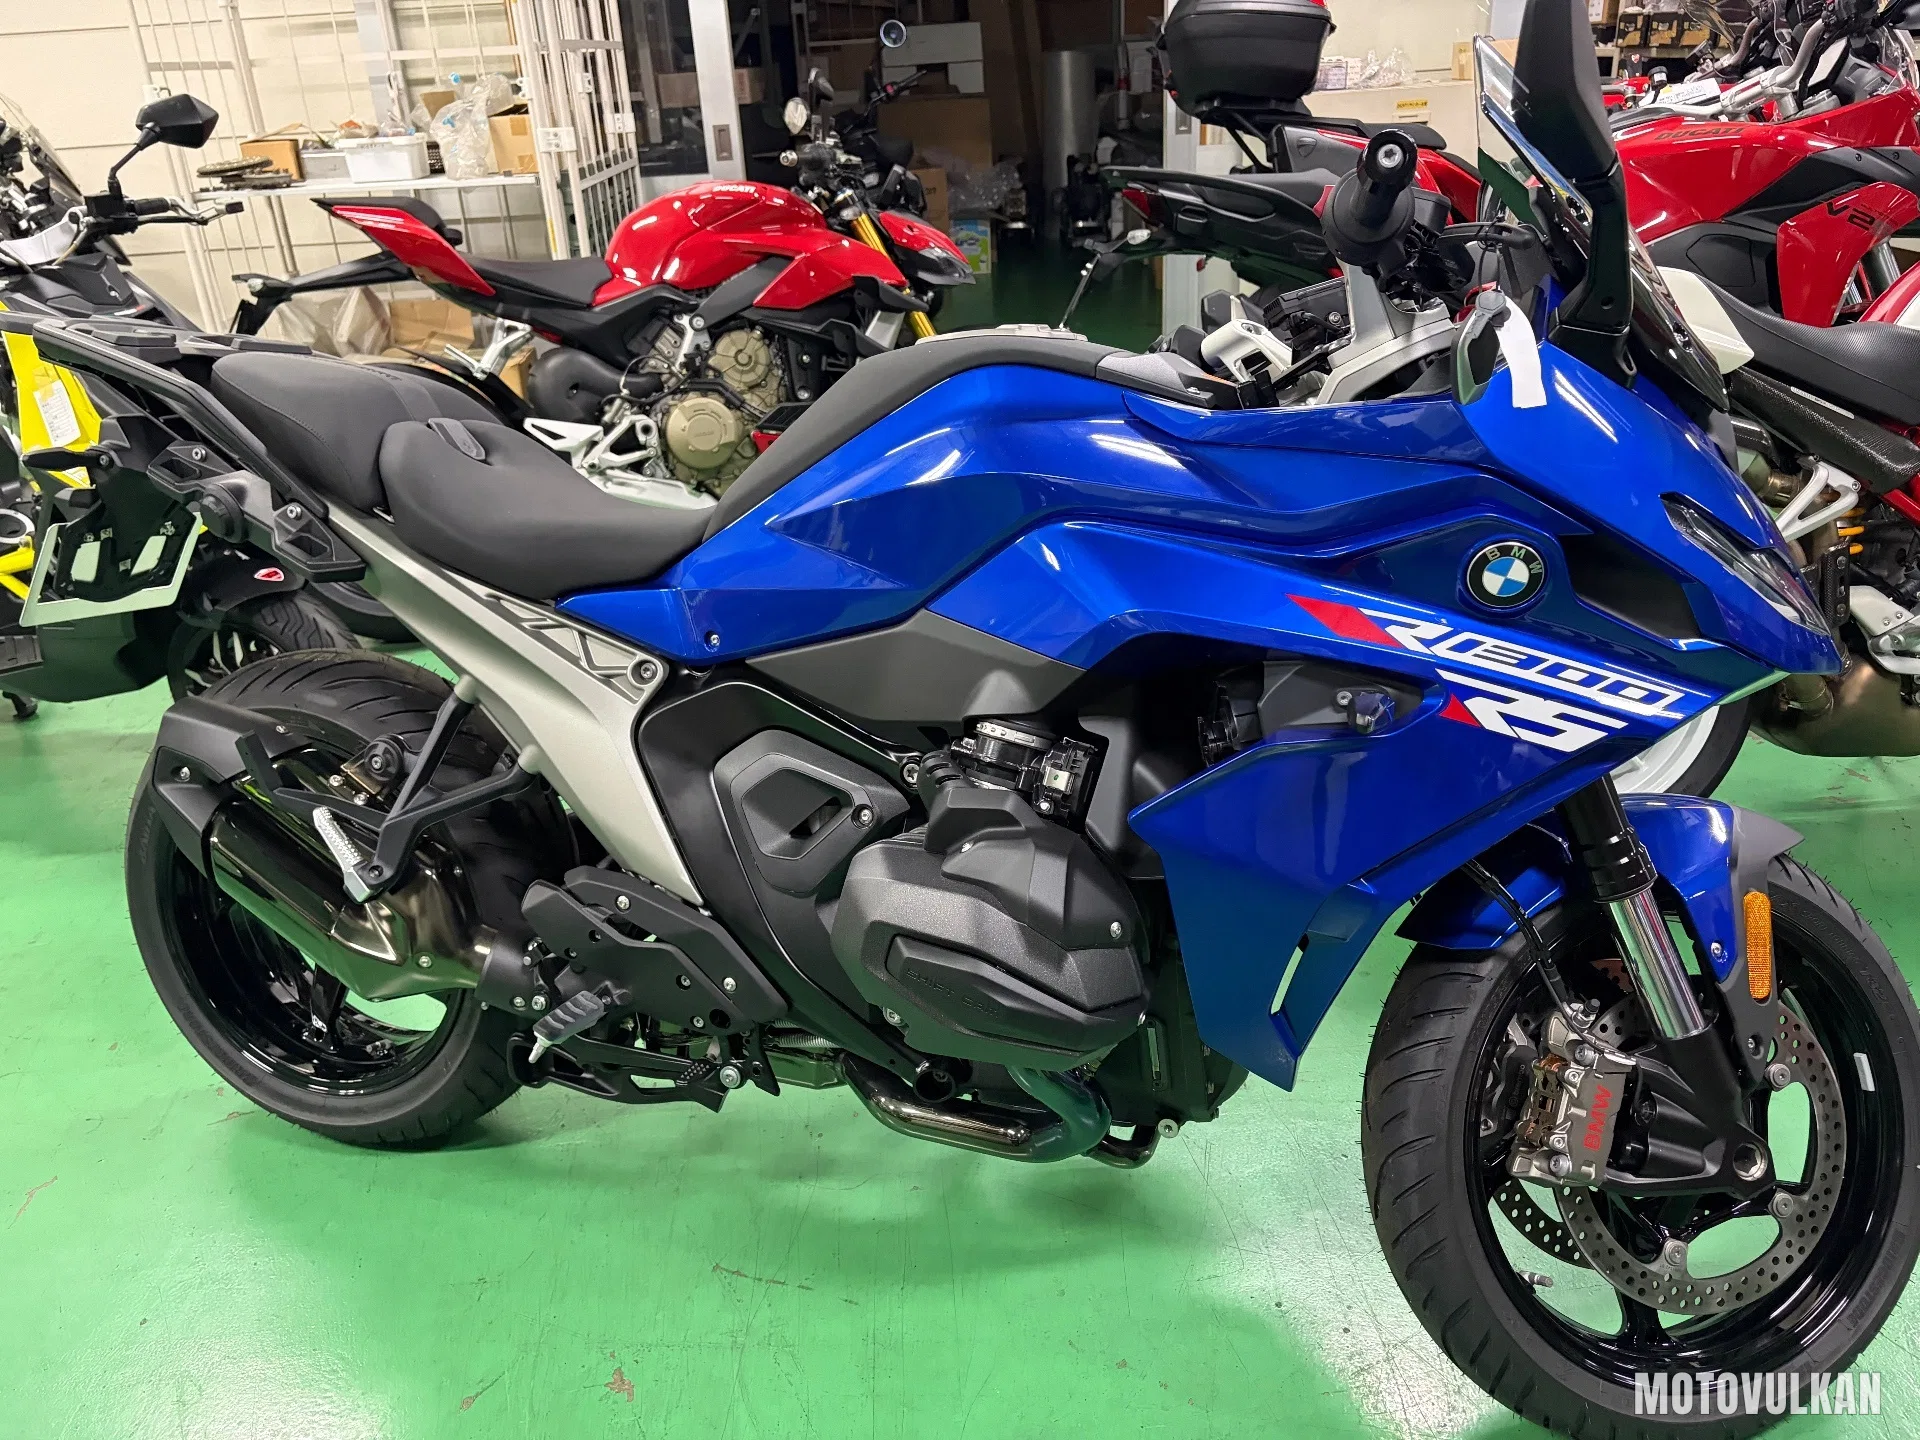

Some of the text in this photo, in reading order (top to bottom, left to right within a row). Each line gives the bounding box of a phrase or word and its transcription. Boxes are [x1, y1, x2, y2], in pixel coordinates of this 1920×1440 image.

[1655, 127, 1745, 140] DUCATI
[713, 184, 757, 194] DUCATI
[1827, 201, 1876, 231] V2
[1485, 545, 1543, 574] BMW
[1434, 668, 1630, 753] RS
[1583, 1084, 1613, 1151] BMW
